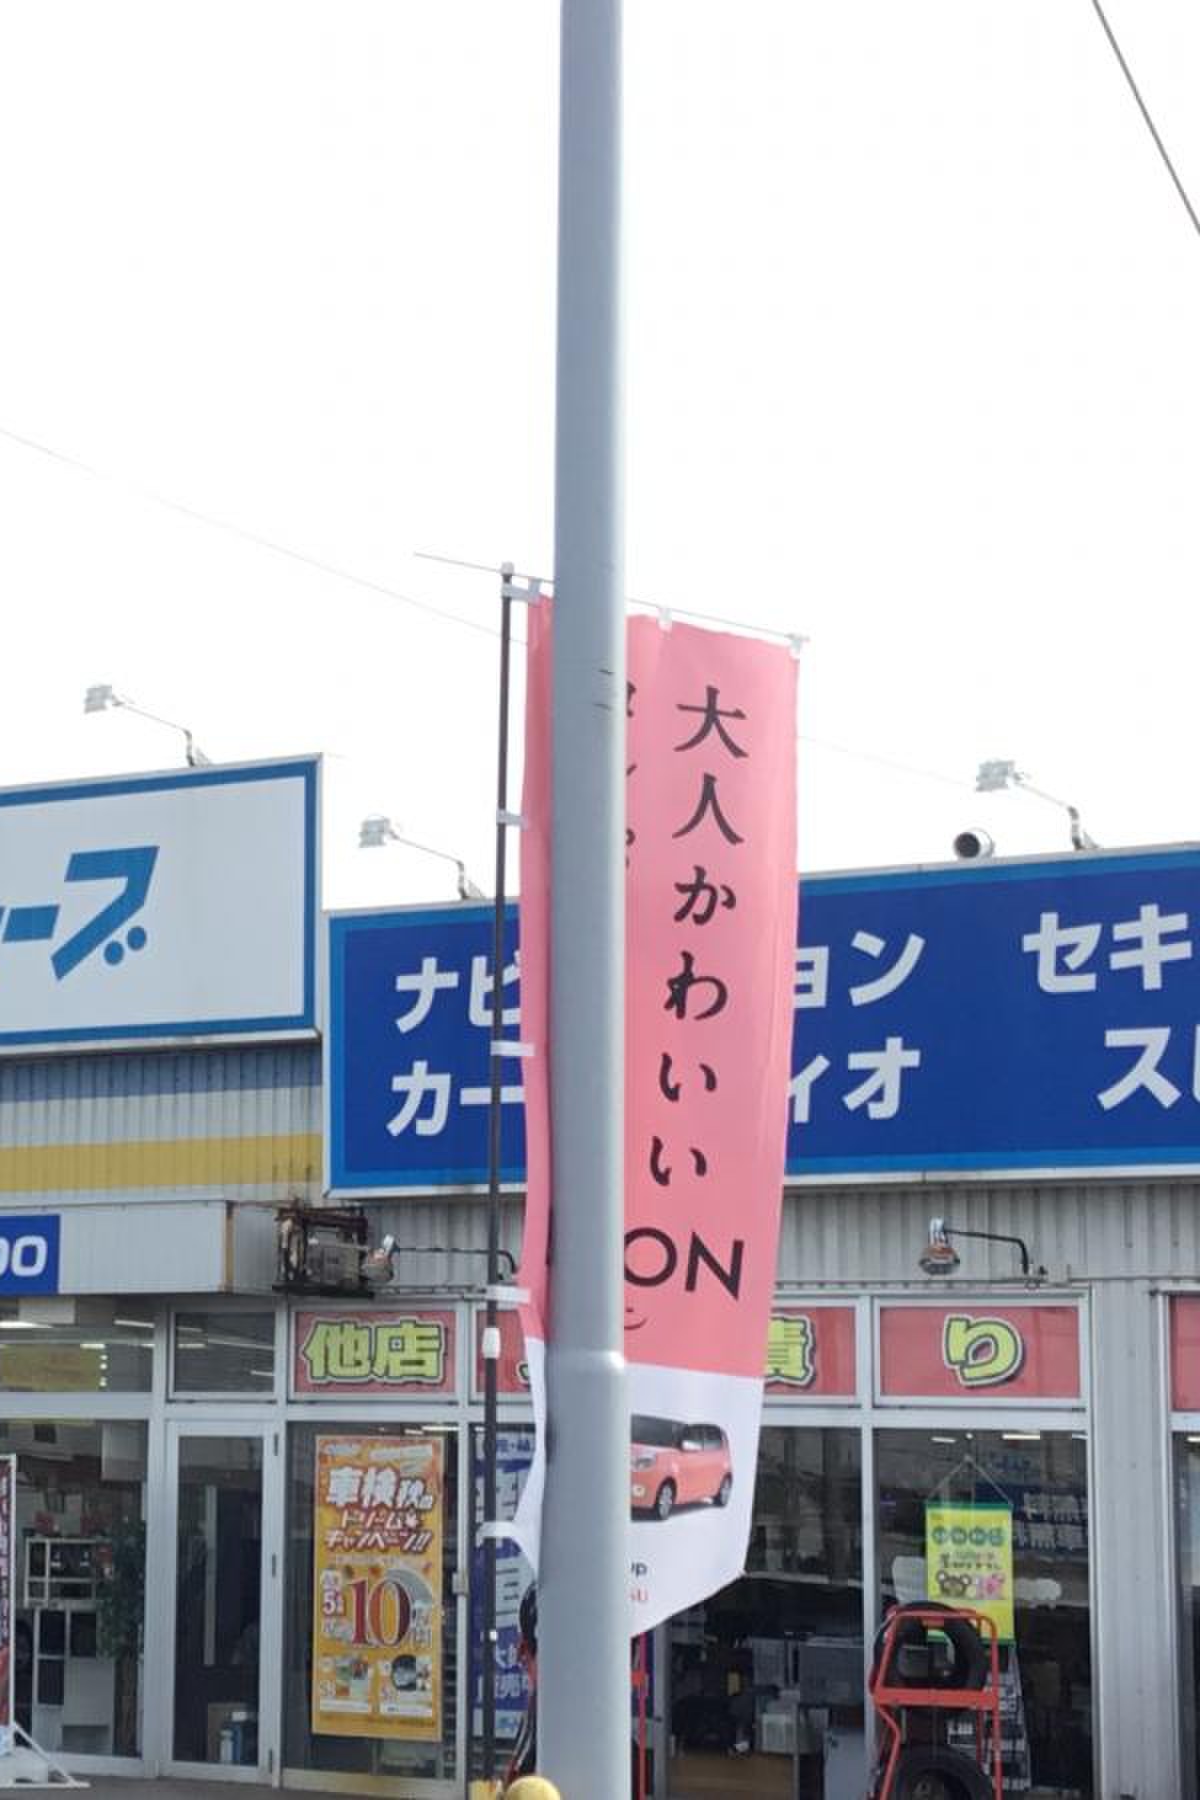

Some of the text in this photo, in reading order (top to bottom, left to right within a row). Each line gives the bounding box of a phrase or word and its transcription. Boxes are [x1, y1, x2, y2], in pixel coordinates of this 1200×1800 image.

[650, 685, 749, 1187] 大人かわいい
[1022, 903, 1193, 993] セキ
[1097, 1024, 1200, 1111] ス
[302, 1317, 444, 1383] 他店
